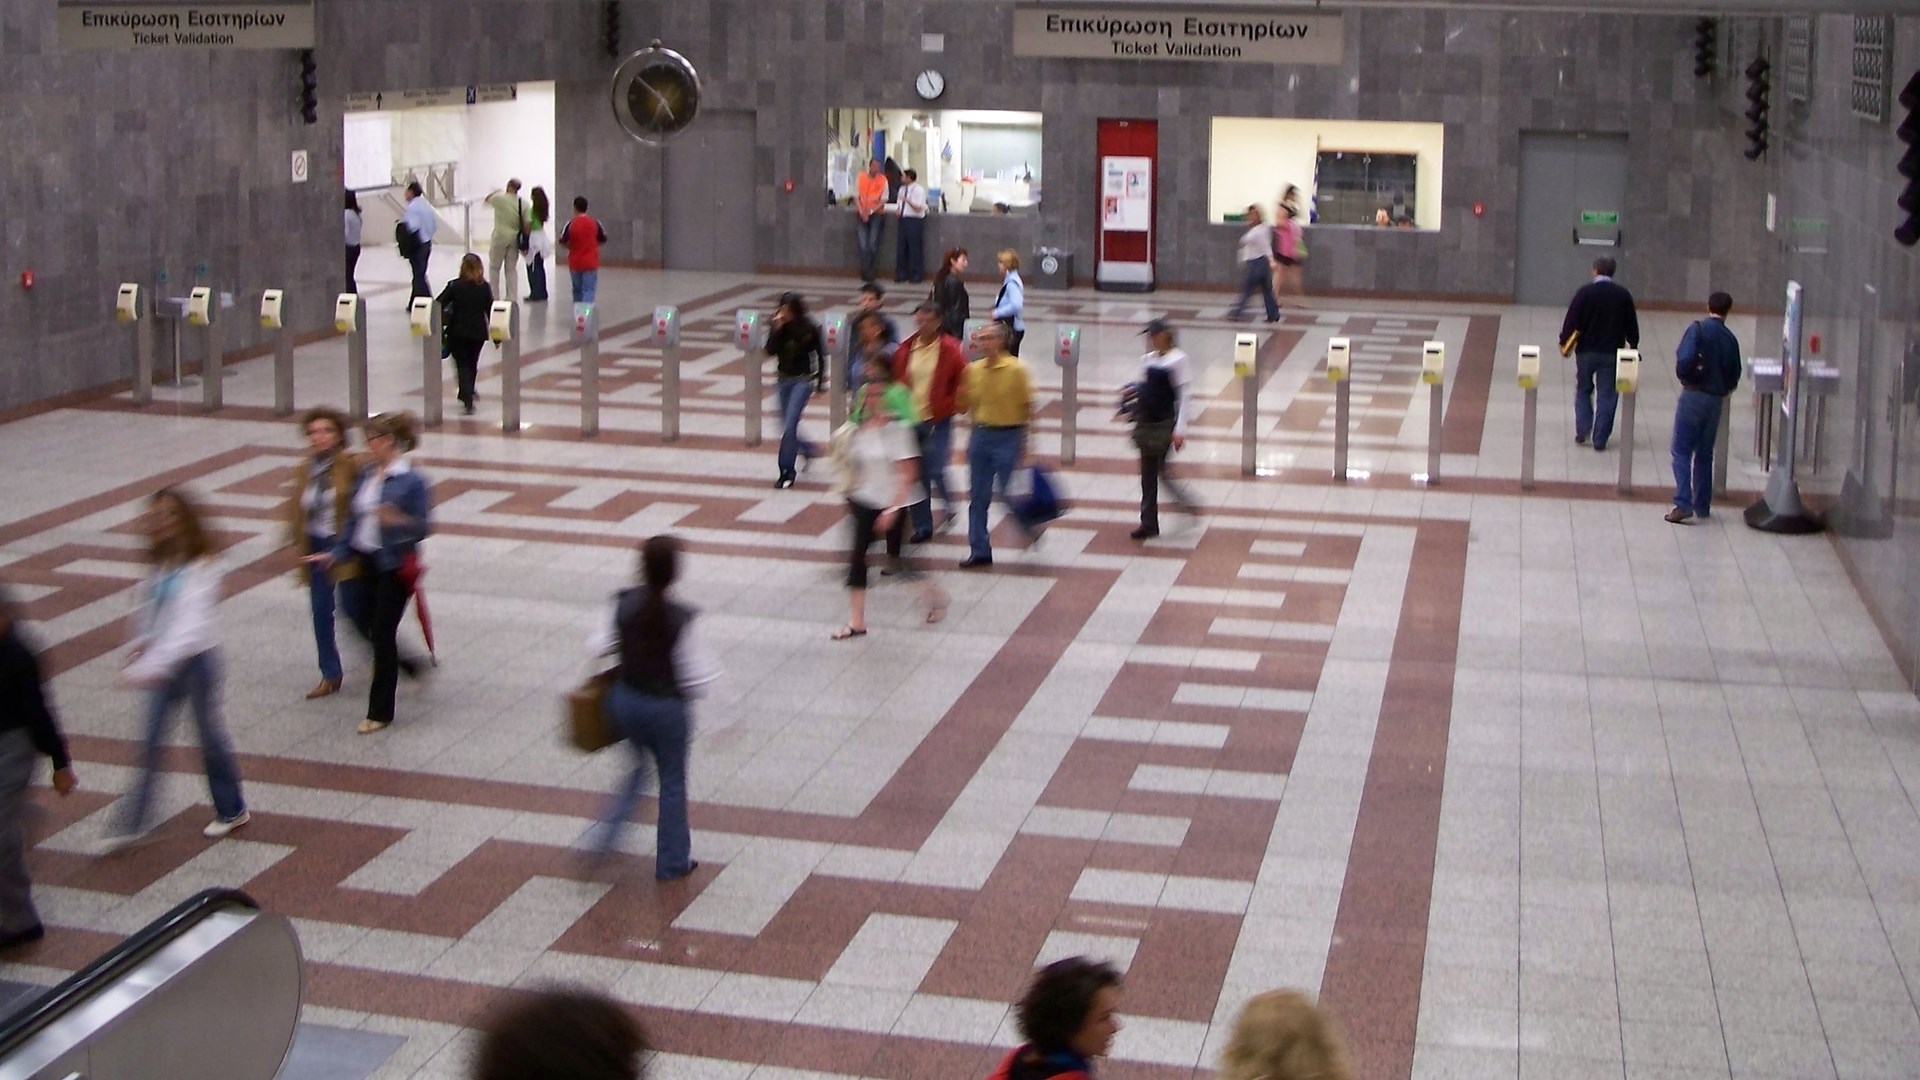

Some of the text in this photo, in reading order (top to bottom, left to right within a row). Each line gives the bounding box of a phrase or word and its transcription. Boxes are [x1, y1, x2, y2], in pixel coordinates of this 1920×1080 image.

[82, 10, 286, 29] Επικύρωση Εισιτηρίων
[1046, 14, 1309, 41] Επικύρωση Εισιτηρίων
[133, 32, 234, 44] Ticket Validation
[1112, 41, 1242, 57] Ticket Validation
